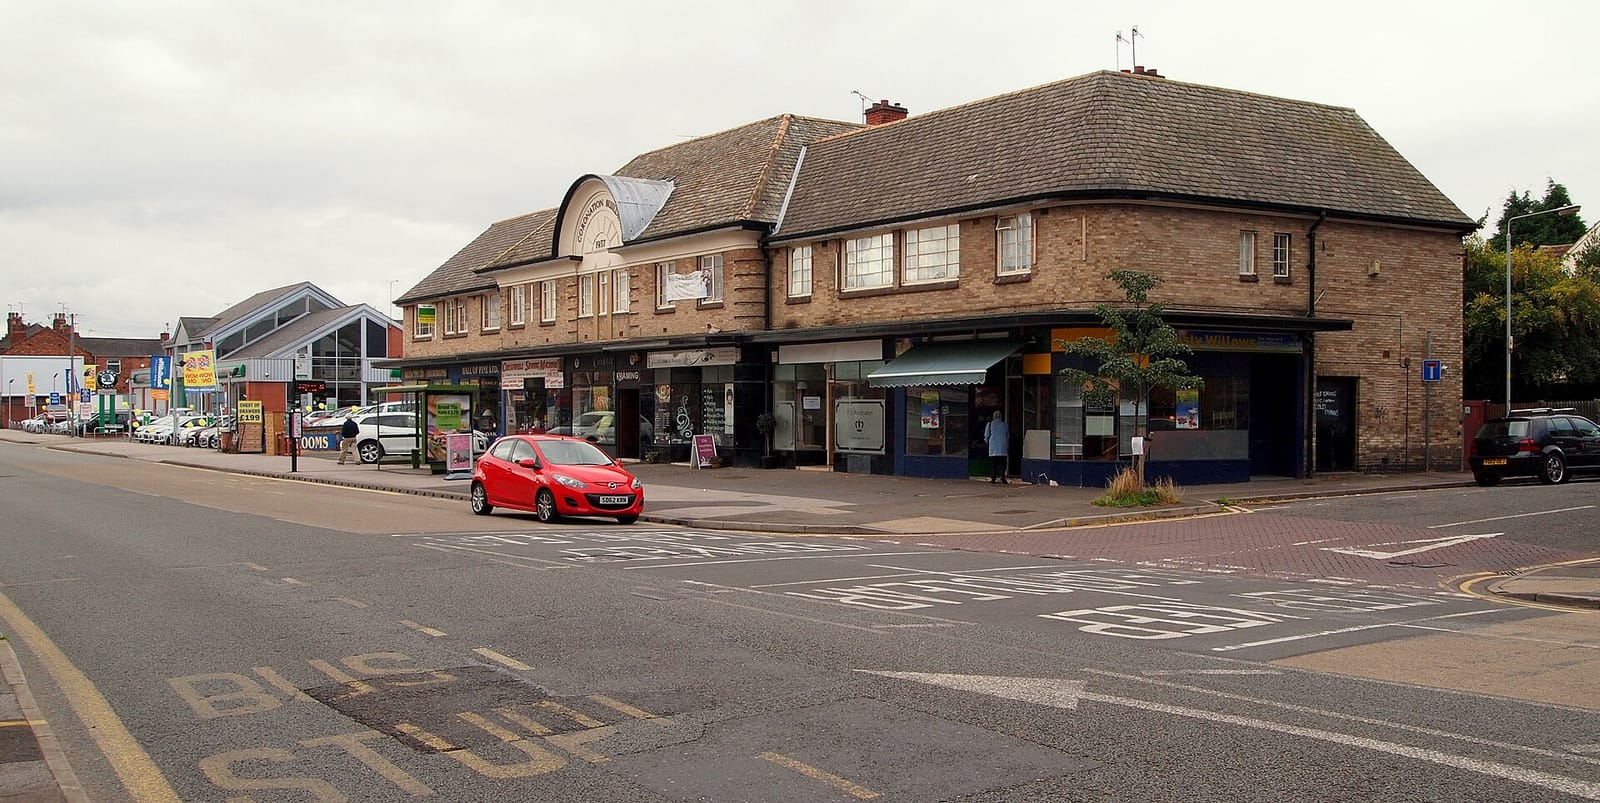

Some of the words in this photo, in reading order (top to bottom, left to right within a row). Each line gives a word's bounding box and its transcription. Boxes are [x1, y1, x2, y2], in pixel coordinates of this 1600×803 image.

[577, 199, 604, 243] CORONATION
[595, 239, 606, 249] 1937
[615, 371, 639, 381] FRAMING
[239, 414, 260, 422] £199
[301, 436, 329, 450] OOMS
[1038, 601, 1311, 640] KEEP
